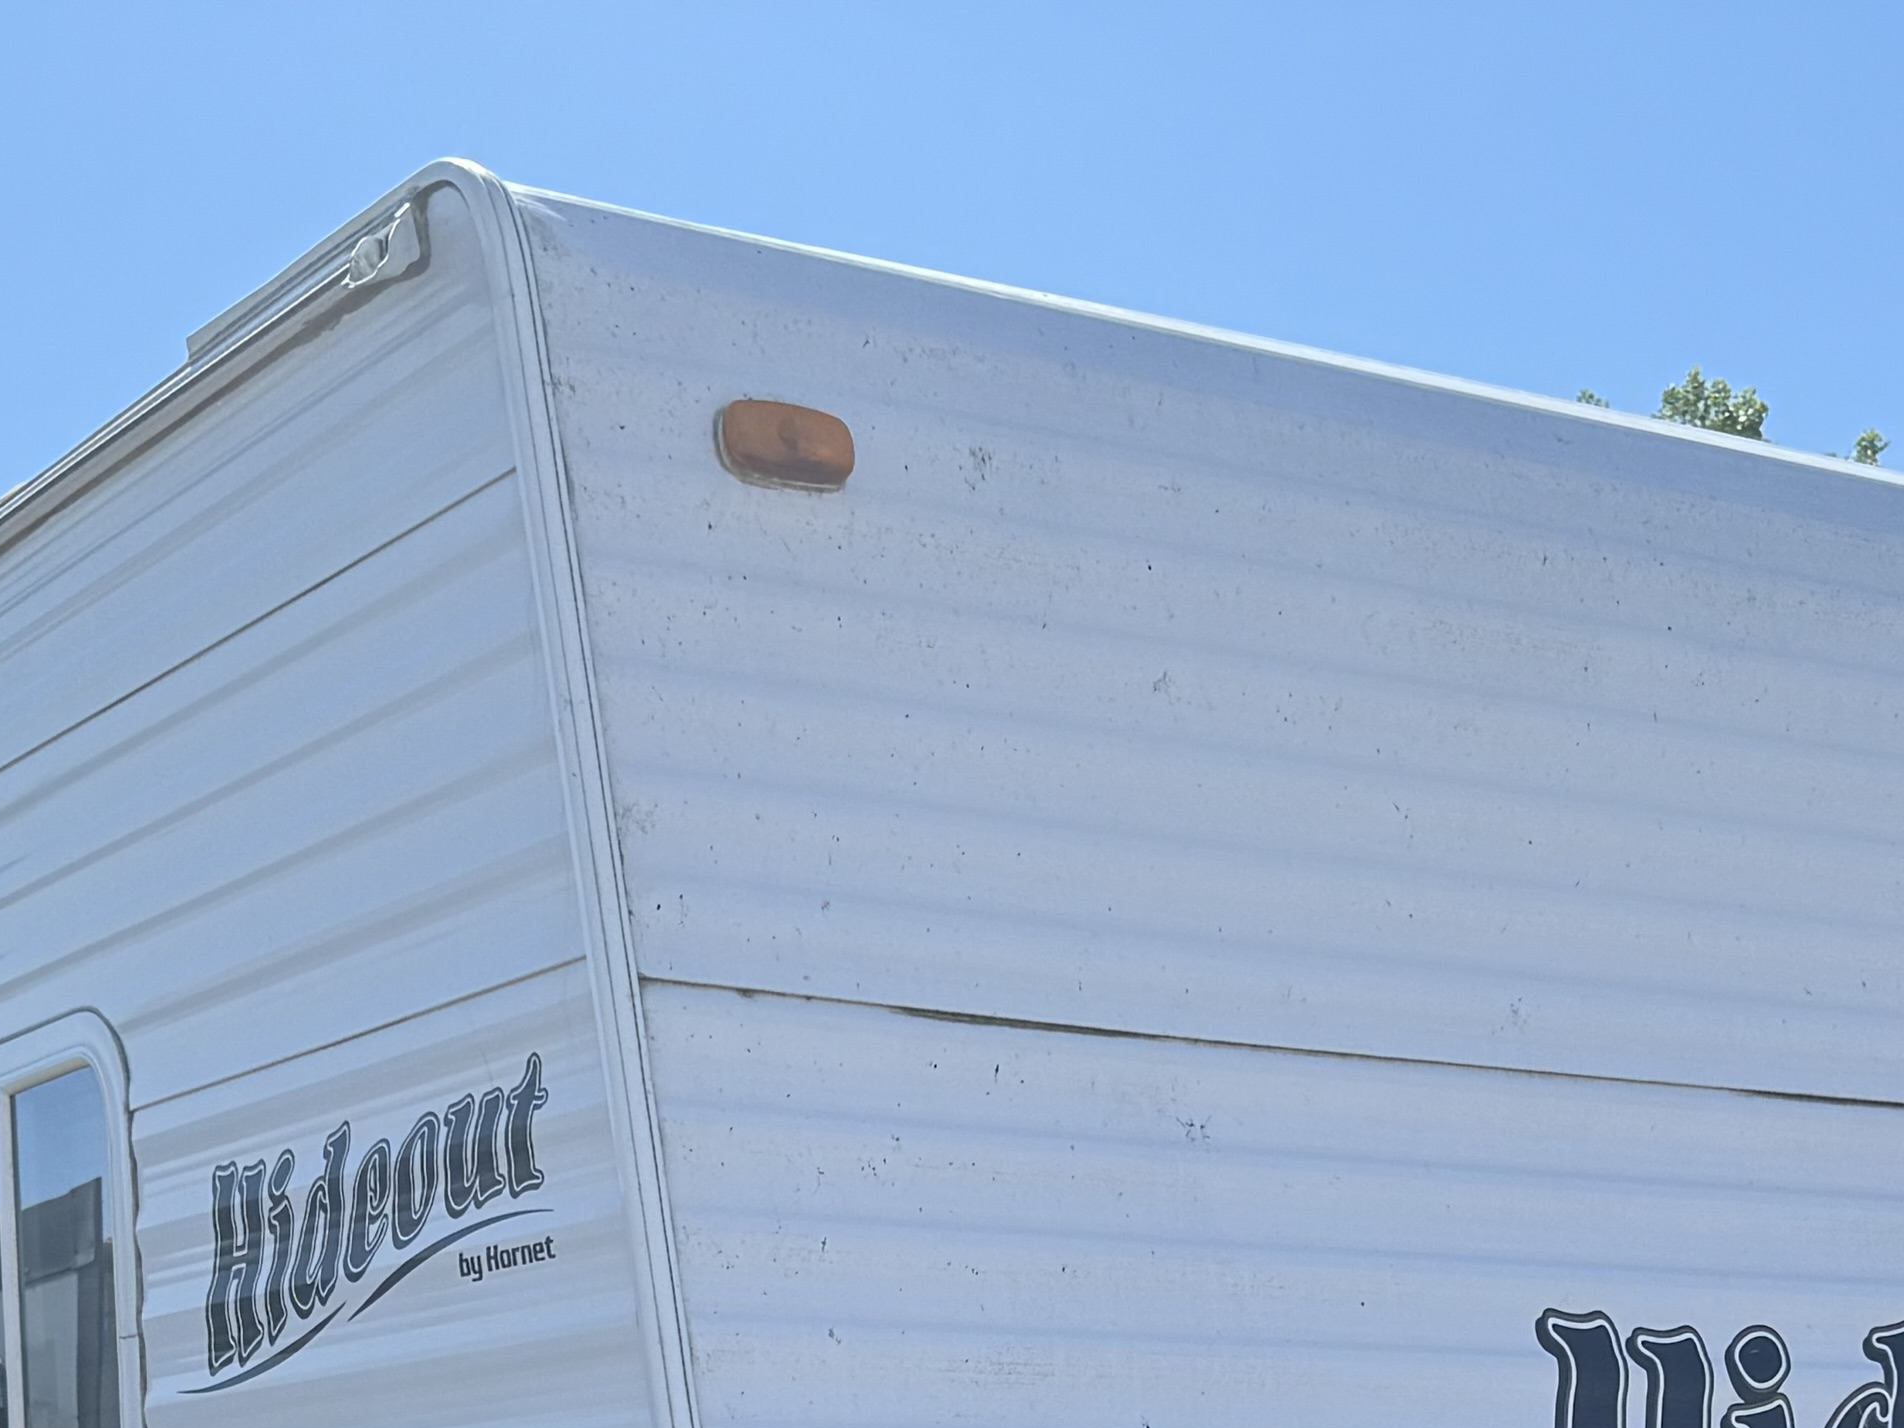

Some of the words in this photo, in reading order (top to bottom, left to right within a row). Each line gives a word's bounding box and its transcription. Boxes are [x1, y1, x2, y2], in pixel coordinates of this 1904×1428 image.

[205, 1051, 548, 1376] Hideout
[458, 1252, 483, 1281] by
[486, 1236, 556, 1272] Hornet
